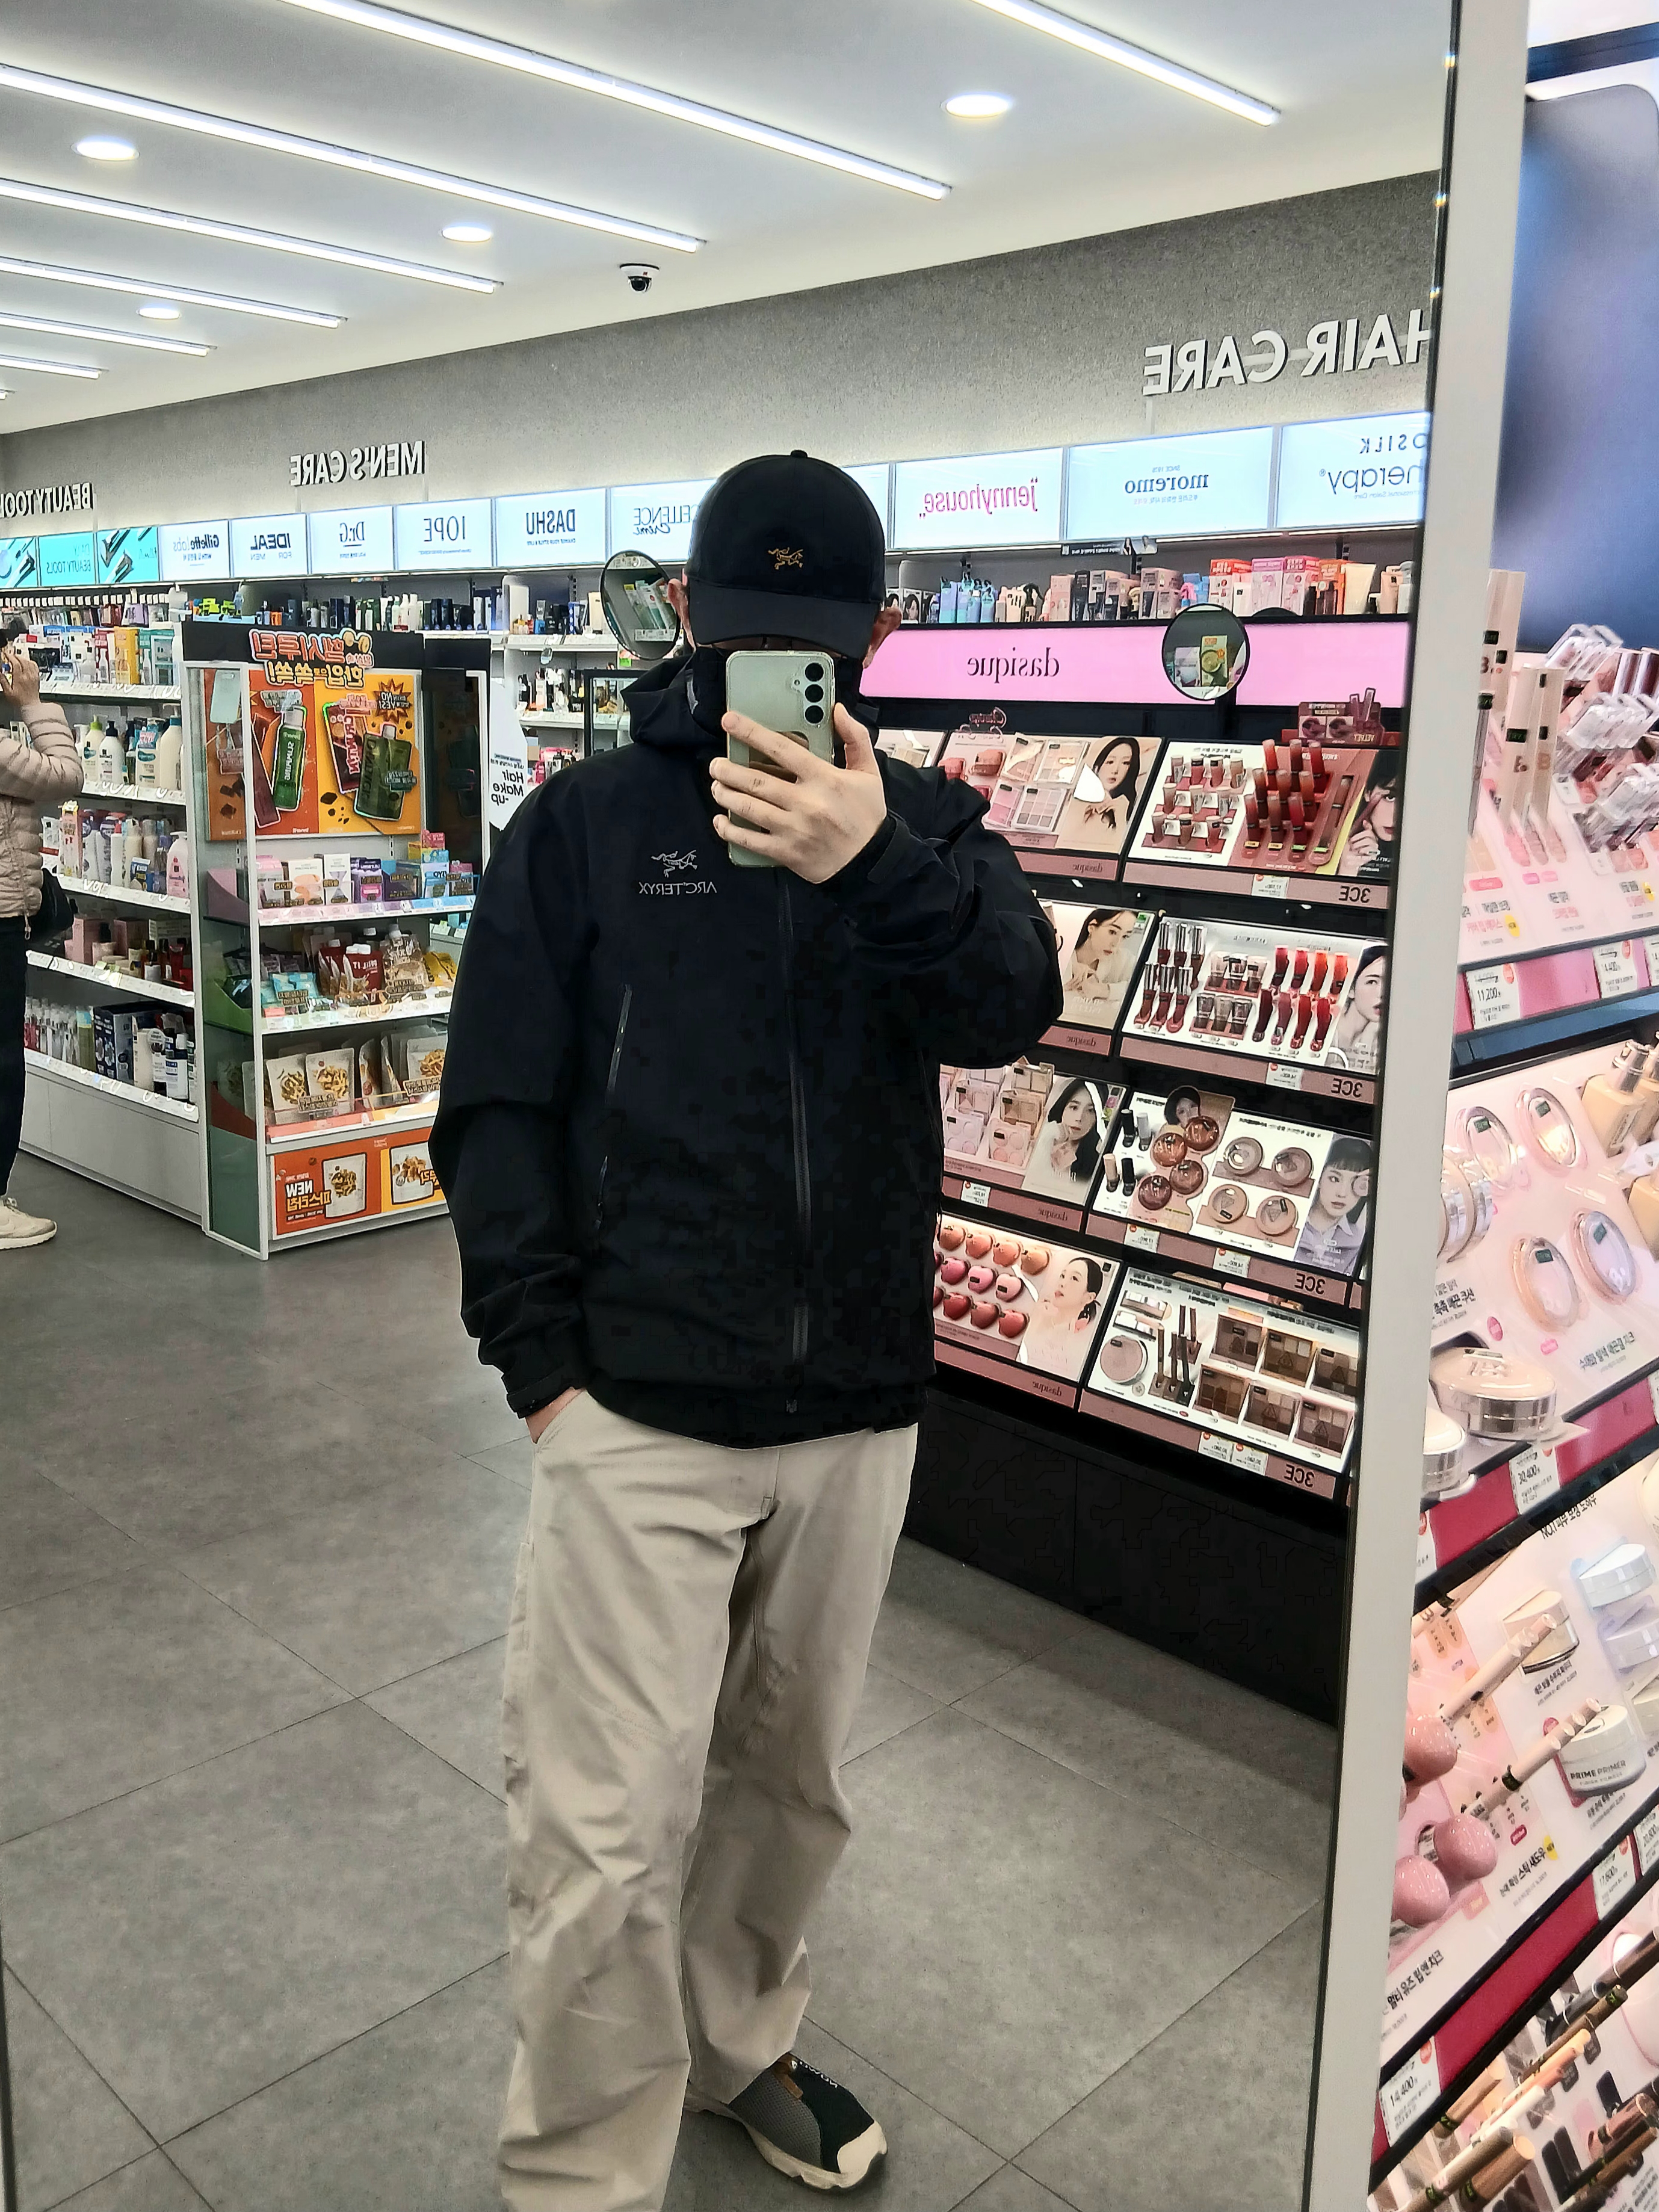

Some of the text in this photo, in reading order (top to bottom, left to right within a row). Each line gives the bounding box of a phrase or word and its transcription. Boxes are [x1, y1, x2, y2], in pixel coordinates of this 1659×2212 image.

[1540, 1521, 1557, 1539] NO.1
[1570, 1770, 1596, 1780] PRIME
[1597, 1760, 1627, 1774] PRIMER
